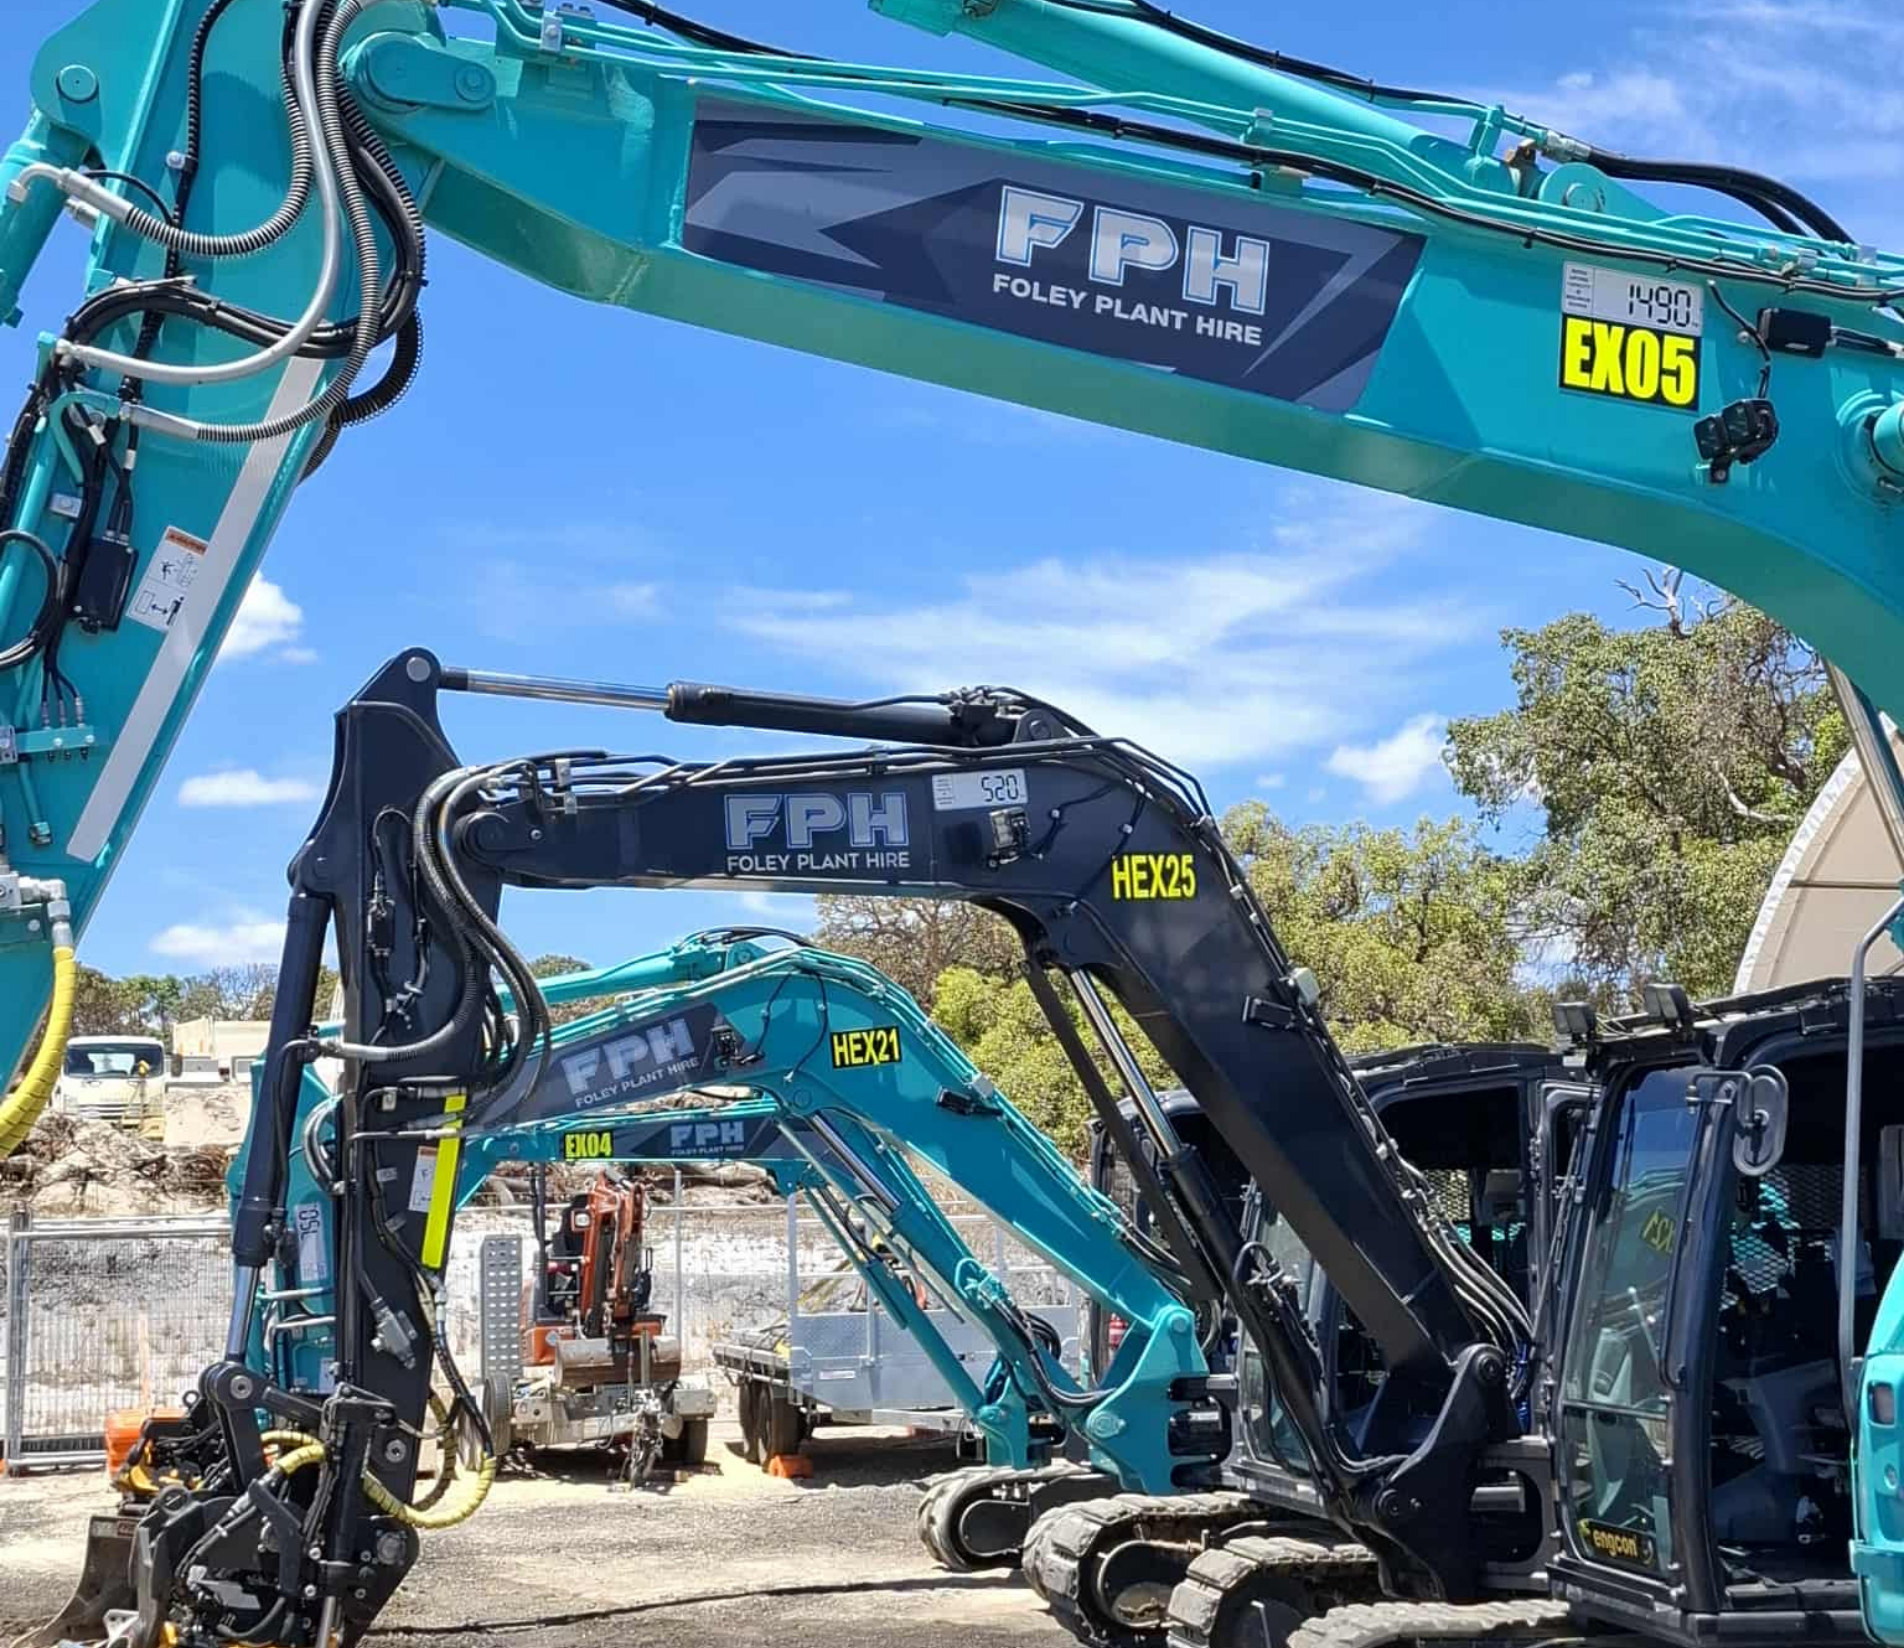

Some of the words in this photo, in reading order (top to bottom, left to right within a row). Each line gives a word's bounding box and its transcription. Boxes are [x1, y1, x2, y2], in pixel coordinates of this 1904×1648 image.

[995, 185, 1270, 316] FPH
[992, 273, 1088, 310] FOLEY
[1094, 294, 1189, 331] PLANT
[1195, 315, 1263, 346] HIRE
[1628, 284, 1692, 327] 1490
[1563, 317, 1697, 405] EX05
[981, 774, 1019, 802] 520
[724, 792, 909, 850] FPH
[726, 854, 790, 872] FOLEY
[797, 853, 860, 870] PLANT
[866, 851, 911, 868] HIRE
[1111, 854, 1197, 899] HEX25
[560, 1018, 695, 1095] FPH
[832, 1028, 900, 1067] HEX21
[574, 1084, 618, 1109] FOLEY
[621, 1069, 665, 1092] PLANT
[666, 1056, 700, 1076] HIRE
[565, 1132, 612, 1157] EX04
[670, 1121, 745, 1147] FPH
[1591, 1529, 1638, 1558] engcon
